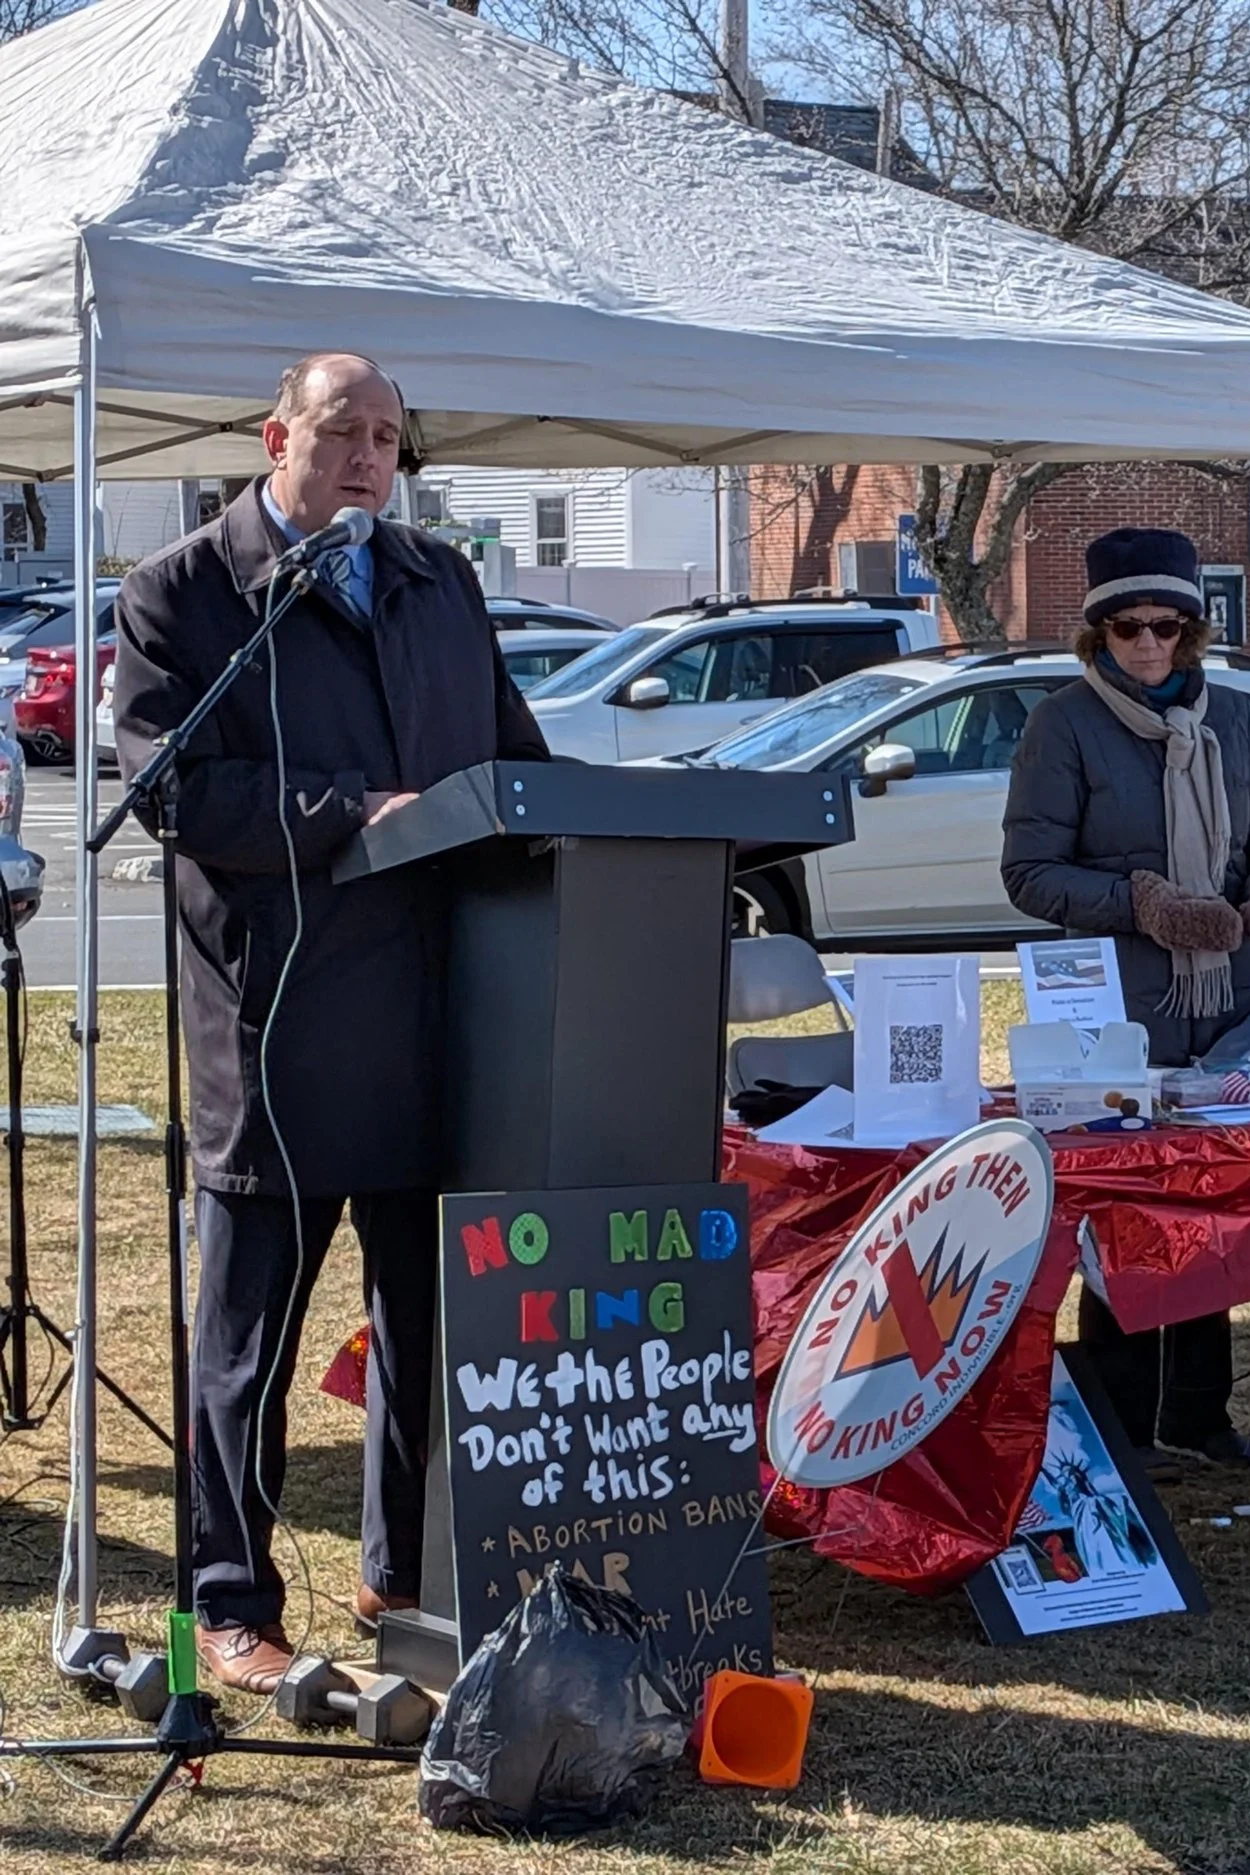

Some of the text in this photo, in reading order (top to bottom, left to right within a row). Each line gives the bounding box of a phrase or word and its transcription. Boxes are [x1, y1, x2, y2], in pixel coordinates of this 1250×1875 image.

[461, 1208, 737, 1277] NO MAD
[809, 1152, 1031, 1350] NO KING THEN
[521, 1282, 685, 1343] KING
[641, 1330, 750, 1405] People
[794, 1280, 1012, 1460] NO KING NOW
[459, 1402, 757, 1472] Don't Want any
[890, 1397, 949, 1451] CONCORD
[521, 1462, 563, 1507] of
[682, 1489, 762, 1527] BANS
[686, 1588, 753, 1635] Hate
